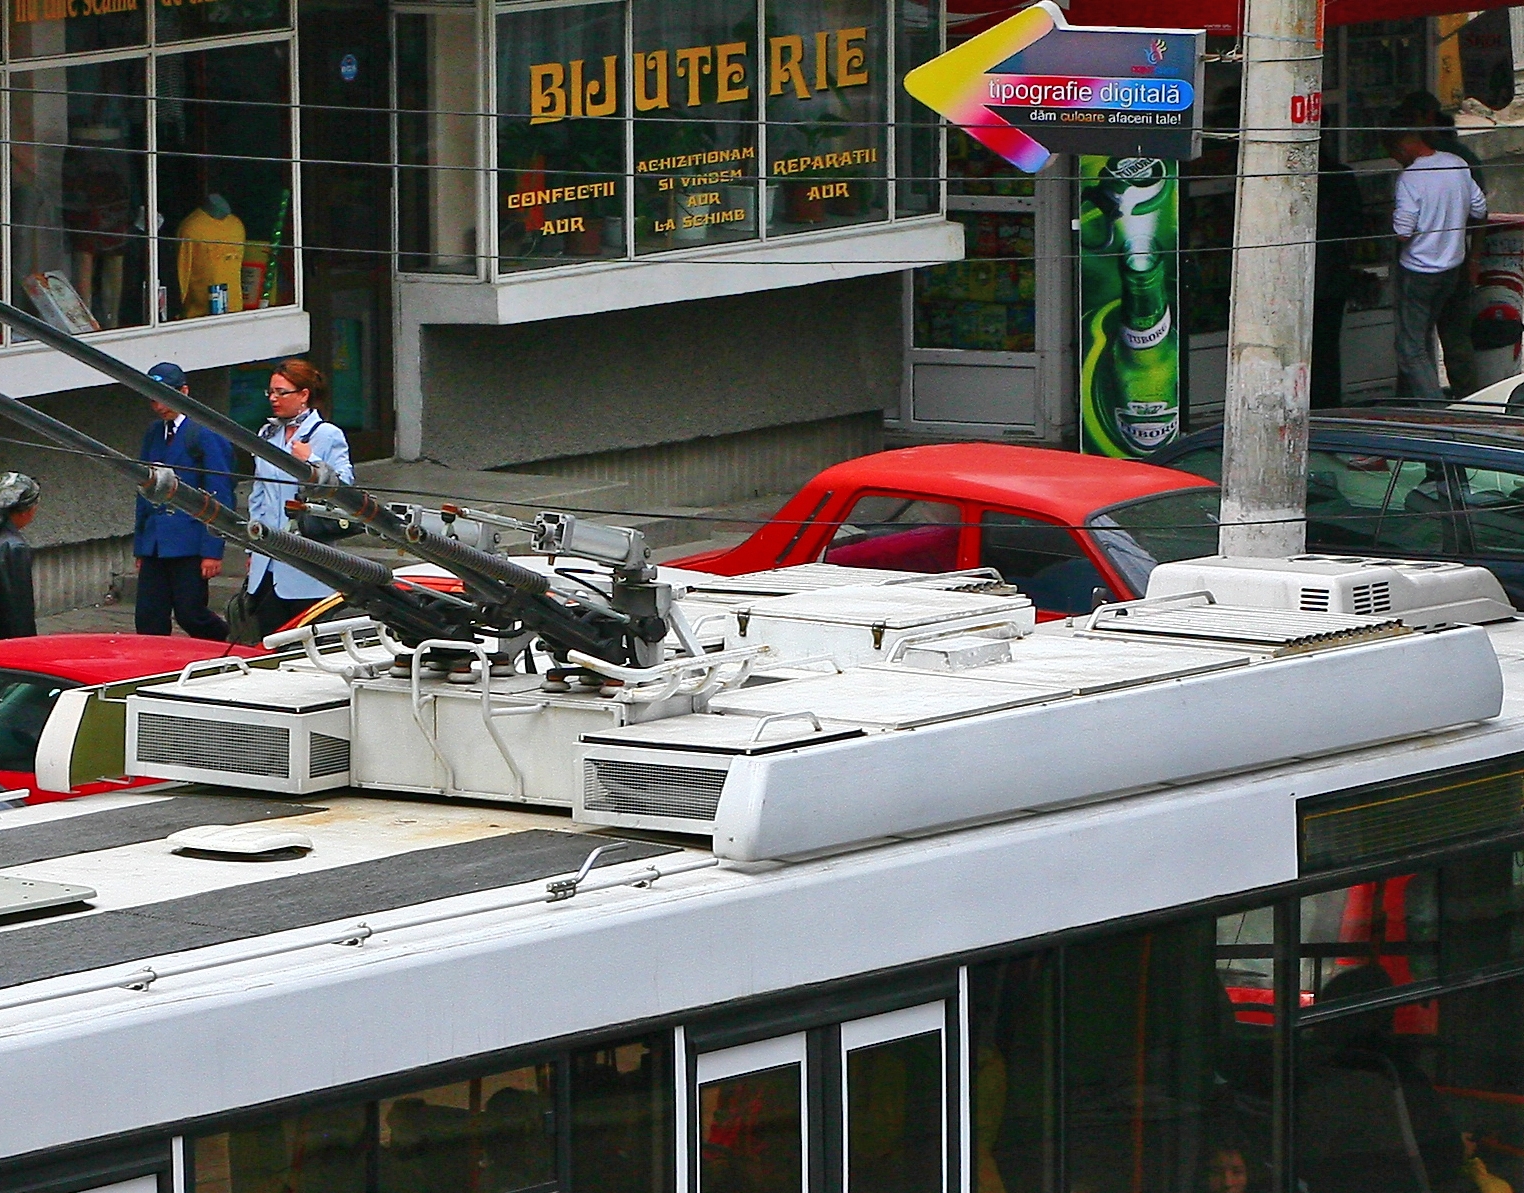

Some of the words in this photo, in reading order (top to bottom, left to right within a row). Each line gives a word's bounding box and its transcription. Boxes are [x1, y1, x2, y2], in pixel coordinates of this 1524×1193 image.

[529, 27, 869, 125] BIJUTERIE
[988, 78, 1093, 105] tipografie
[1099, 82, 1180, 108] digitală
[1030, 109, 1057, 121] dăm
[1060, 111, 1105, 122] culoare
[1108, 112, 1152, 124] afacerii
[1155, 114, 1182, 125] tale!
[636, 146, 755, 173] ACHIZITIONAM
[773, 148, 877, 176] REPARATII
[658, 178, 675, 192] SI
[681, 169, 743, 188] VINDEM
[806, 182, 850, 201] AUR
[507, 181, 615, 209] CONFECTII
[686, 192, 722, 208] AUR
[540, 217, 586, 236] AUR
[654, 219, 676, 233] LA
[682, 208, 746, 229] SCHIMB
[1127, 322, 1167, 344] TUBORG
